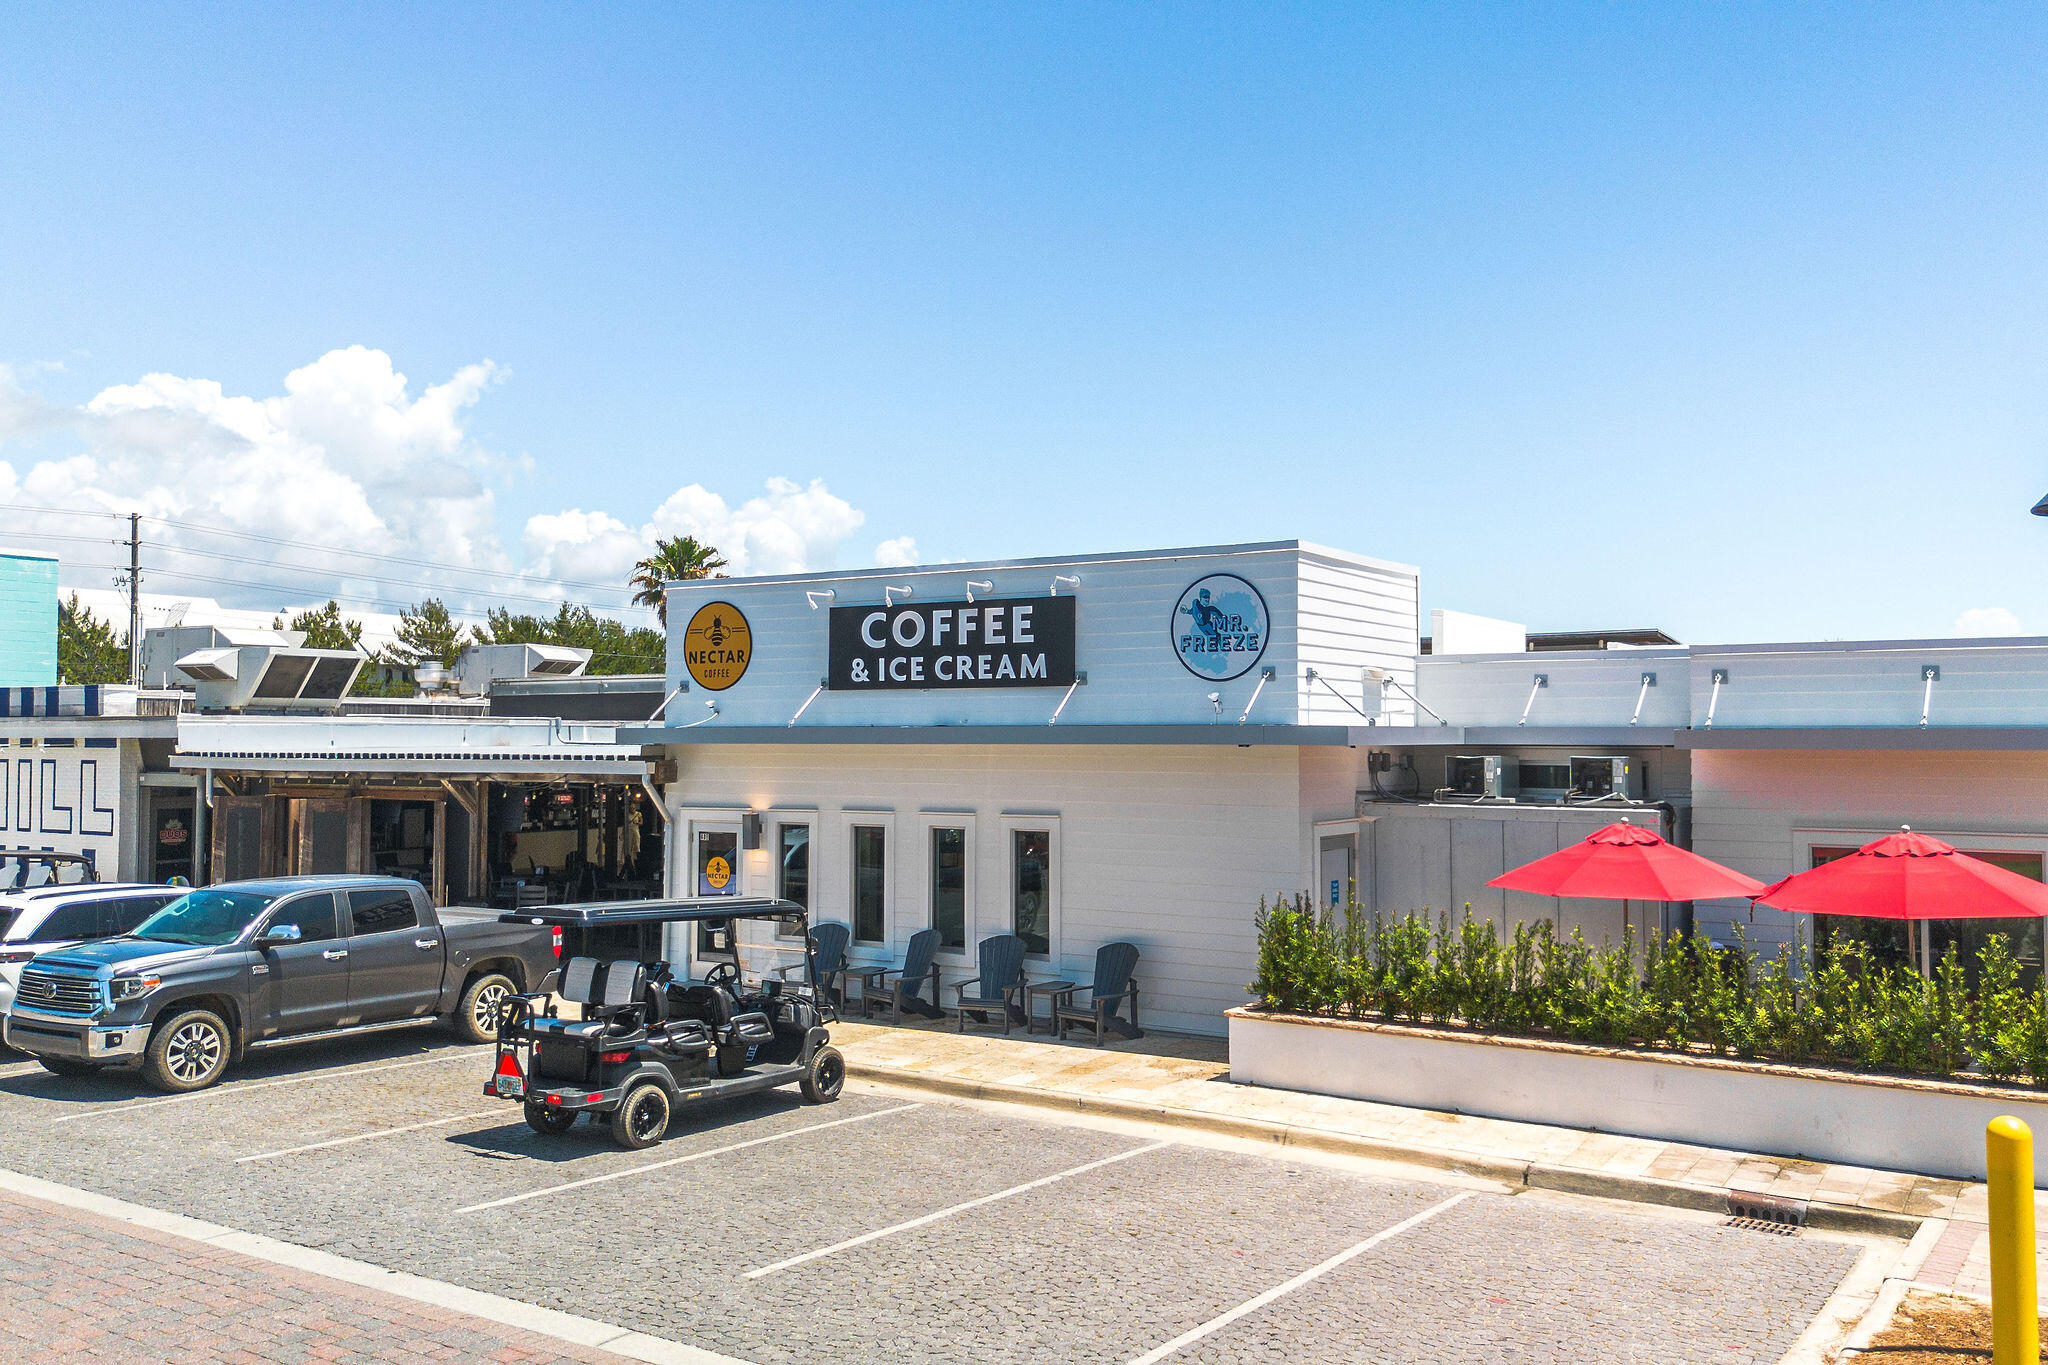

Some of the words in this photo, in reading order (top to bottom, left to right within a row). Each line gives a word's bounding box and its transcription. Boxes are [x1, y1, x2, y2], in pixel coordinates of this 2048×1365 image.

[861, 605, 1035, 648] COFFEE
[1212, 614, 1248, 632] MR.
[1180, 633, 1259, 653] FREEZE
[688, 650, 745, 664] NECTAR
[704, 669, 730, 678] COFFEE
[851, 658, 870, 683] &
[878, 656, 924, 682] ICE
[935, 653, 1047, 680] CREAM
[0, 759, 113, 836] ILL
